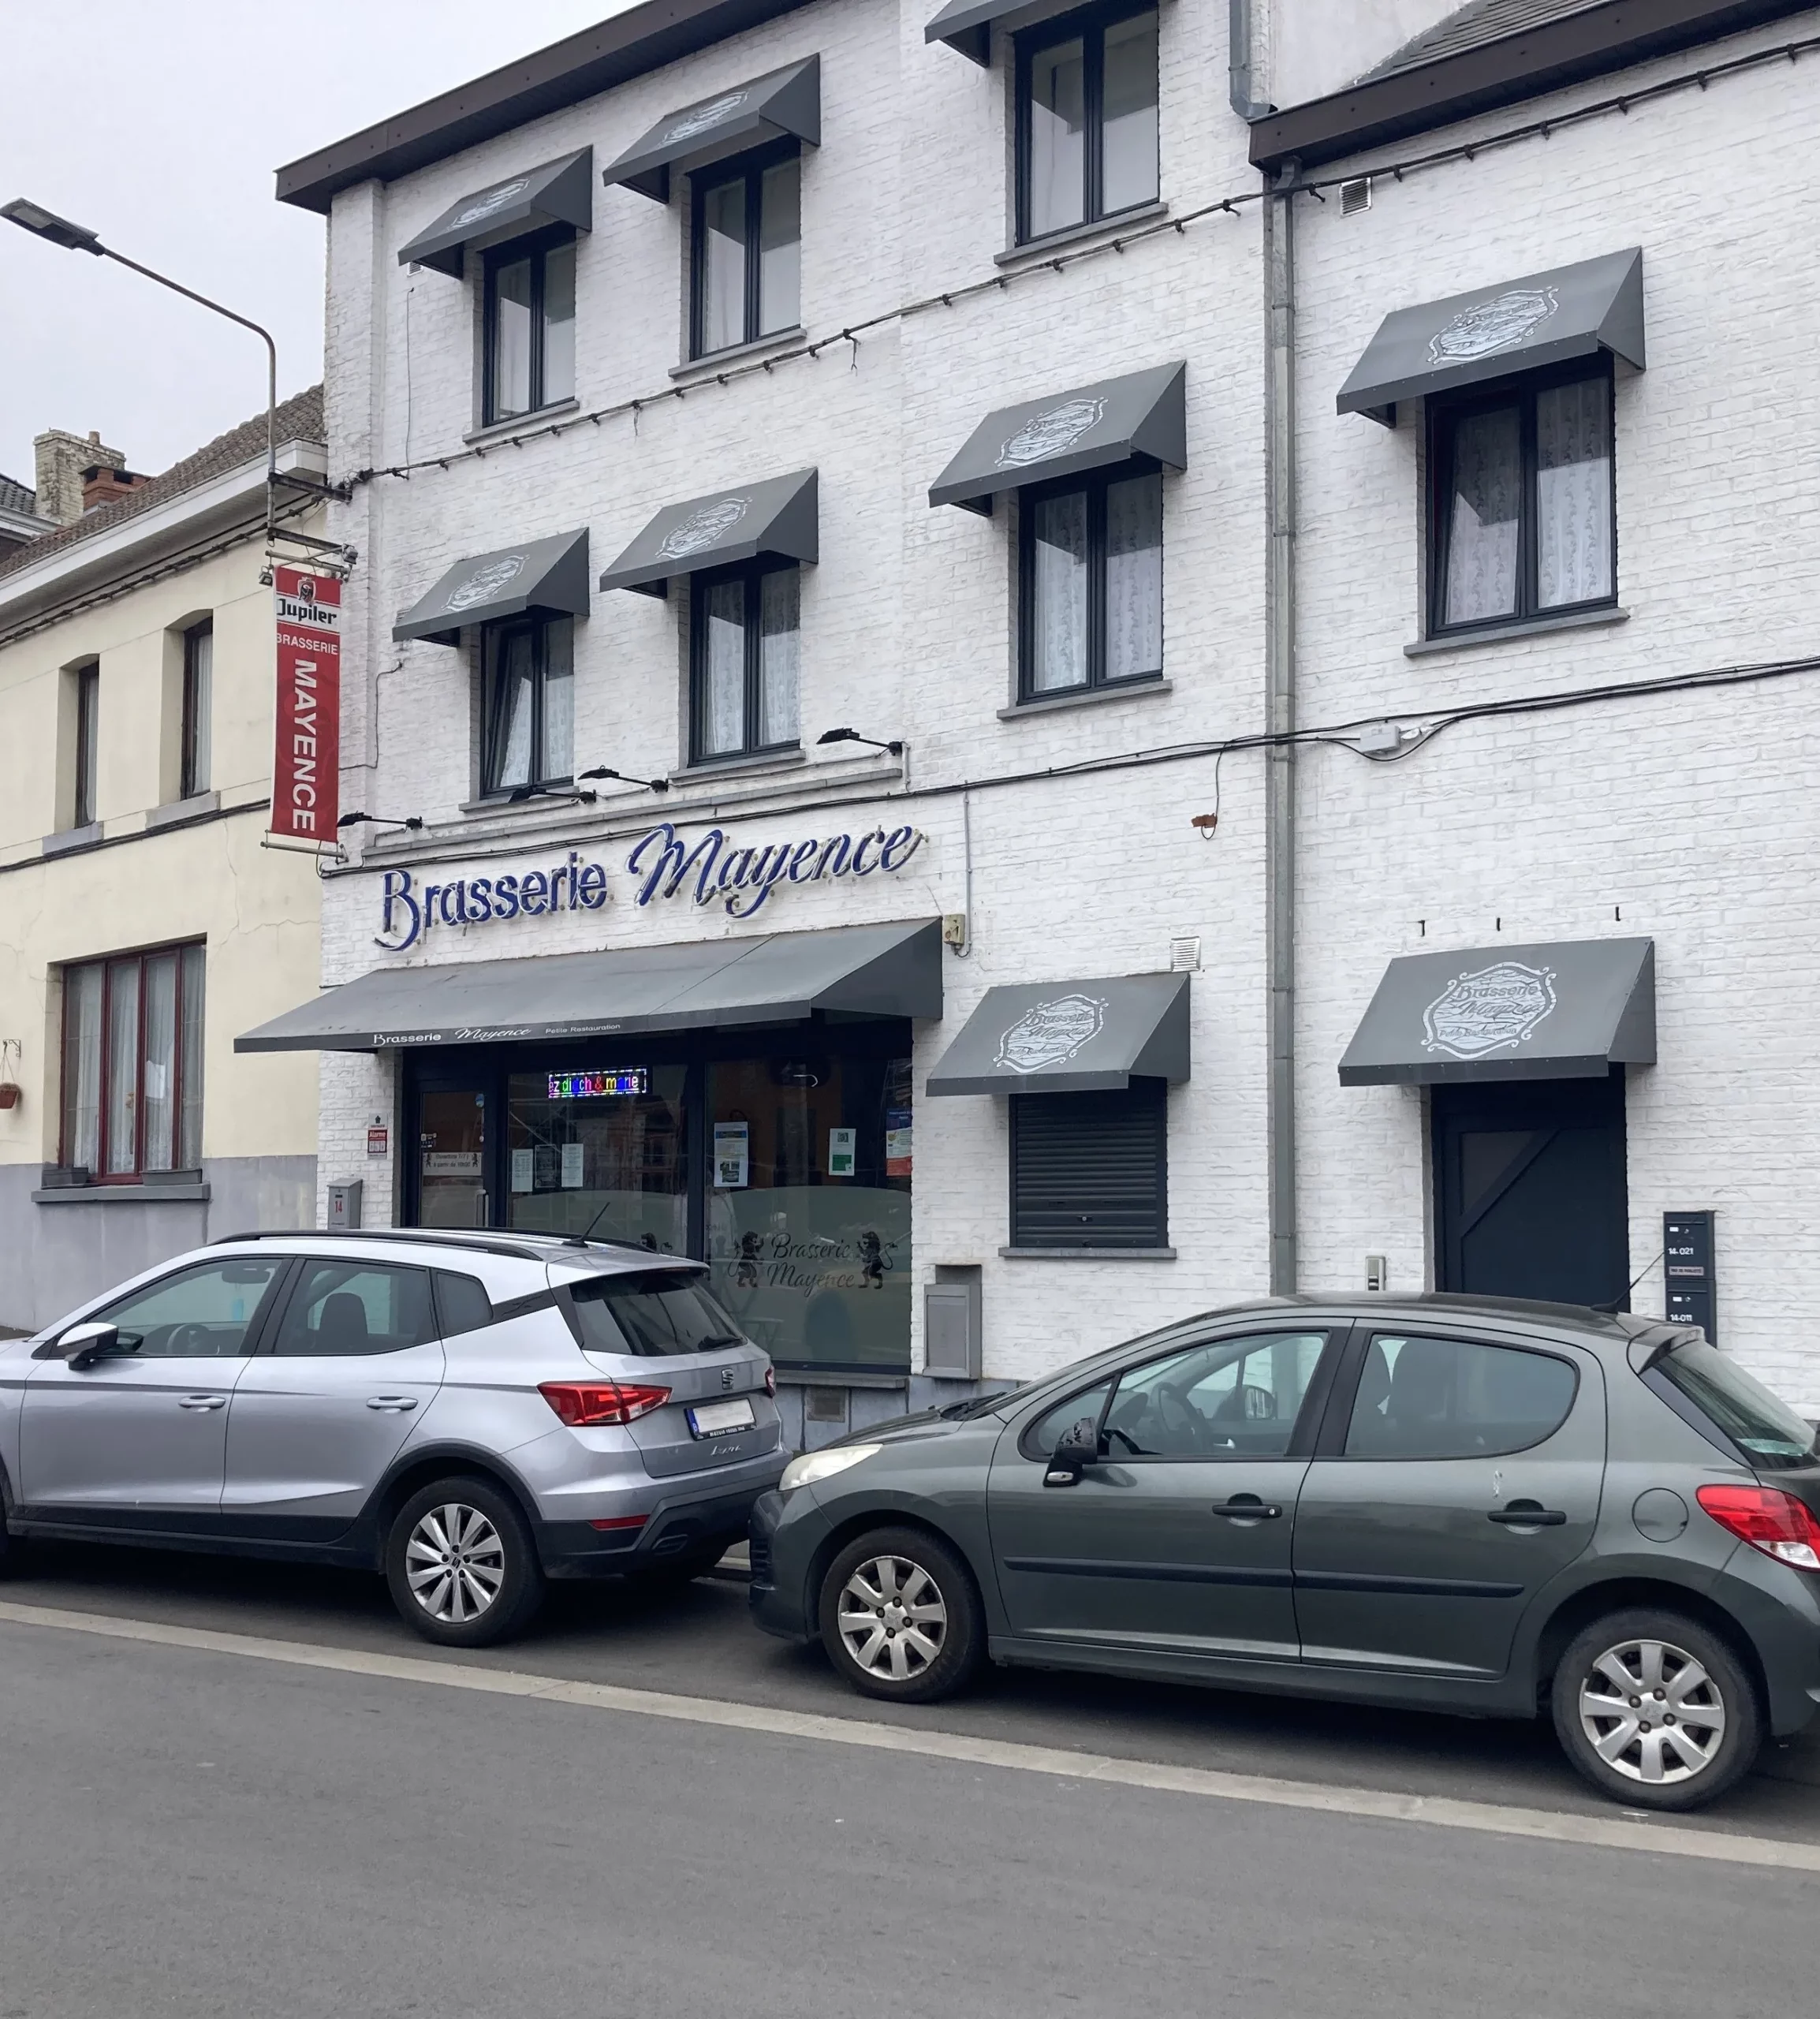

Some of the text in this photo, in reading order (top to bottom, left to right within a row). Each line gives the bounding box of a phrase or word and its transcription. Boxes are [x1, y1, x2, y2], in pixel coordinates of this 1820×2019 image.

[277, 598, 337, 625] Jupiler
[277, 633, 338, 655] BRASSERIE
[293, 659, 317, 832] MAYENCE
[371, 823, 928, 953] Brasserie Mayence
[371, 1033, 442, 1047] Brasserie
[455, 1027, 531, 1041] Mayence
[570, 1024, 621, 1032] Restauration
[334, 1200, 343, 1214] 14
[771, 1233, 851, 1259] Brasserie
[767, 1262, 856, 1297] Mayence
